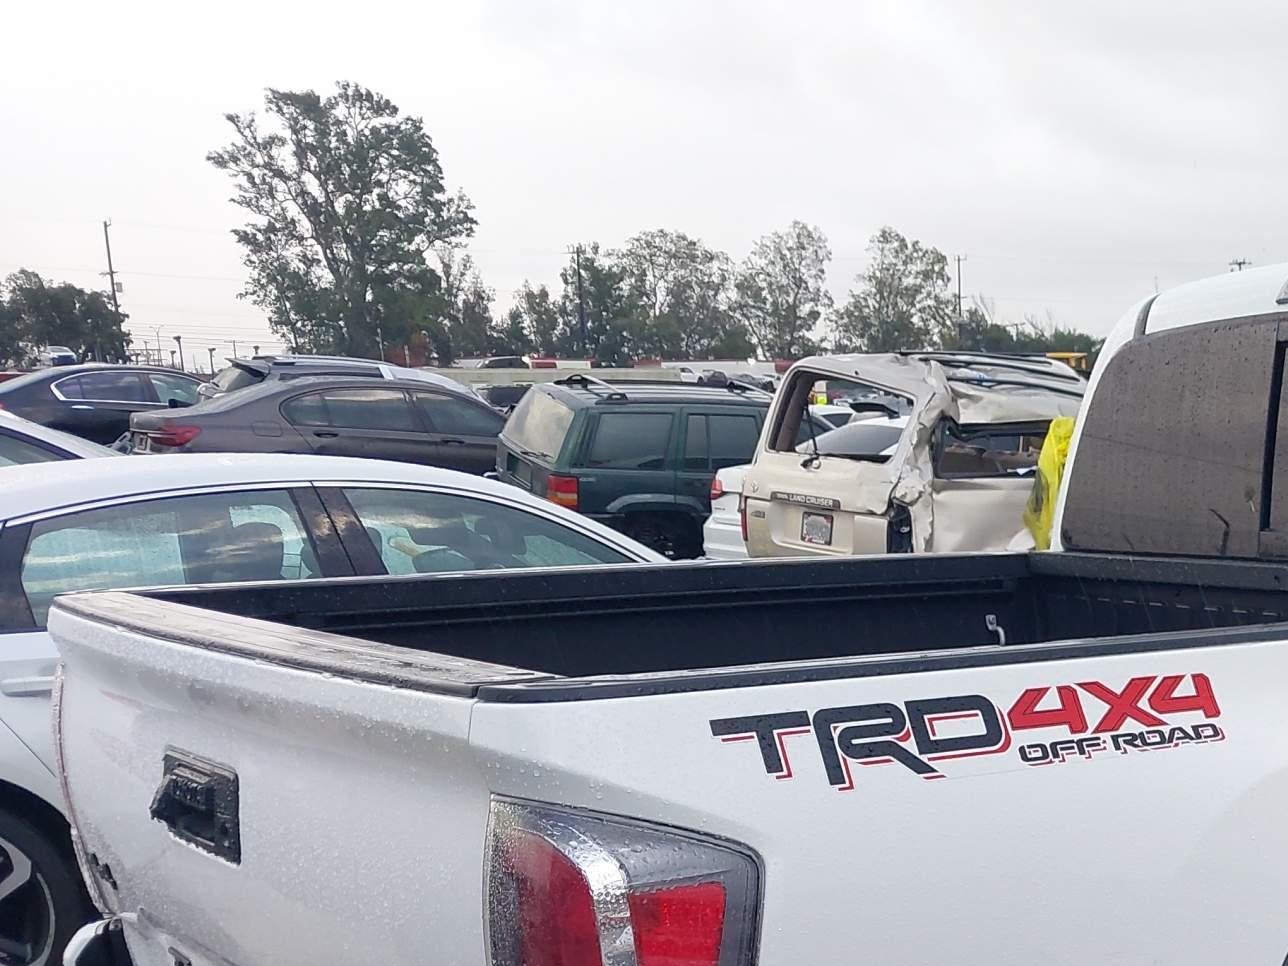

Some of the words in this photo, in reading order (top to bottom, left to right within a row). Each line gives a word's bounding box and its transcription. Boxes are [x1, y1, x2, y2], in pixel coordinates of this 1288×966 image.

[806, 496, 833, 508] CRUISER
[709, 694, 1011, 791] TRD
[1018, 737, 1107, 765] OFF
[1111, 723, 1226, 755] ROAD
